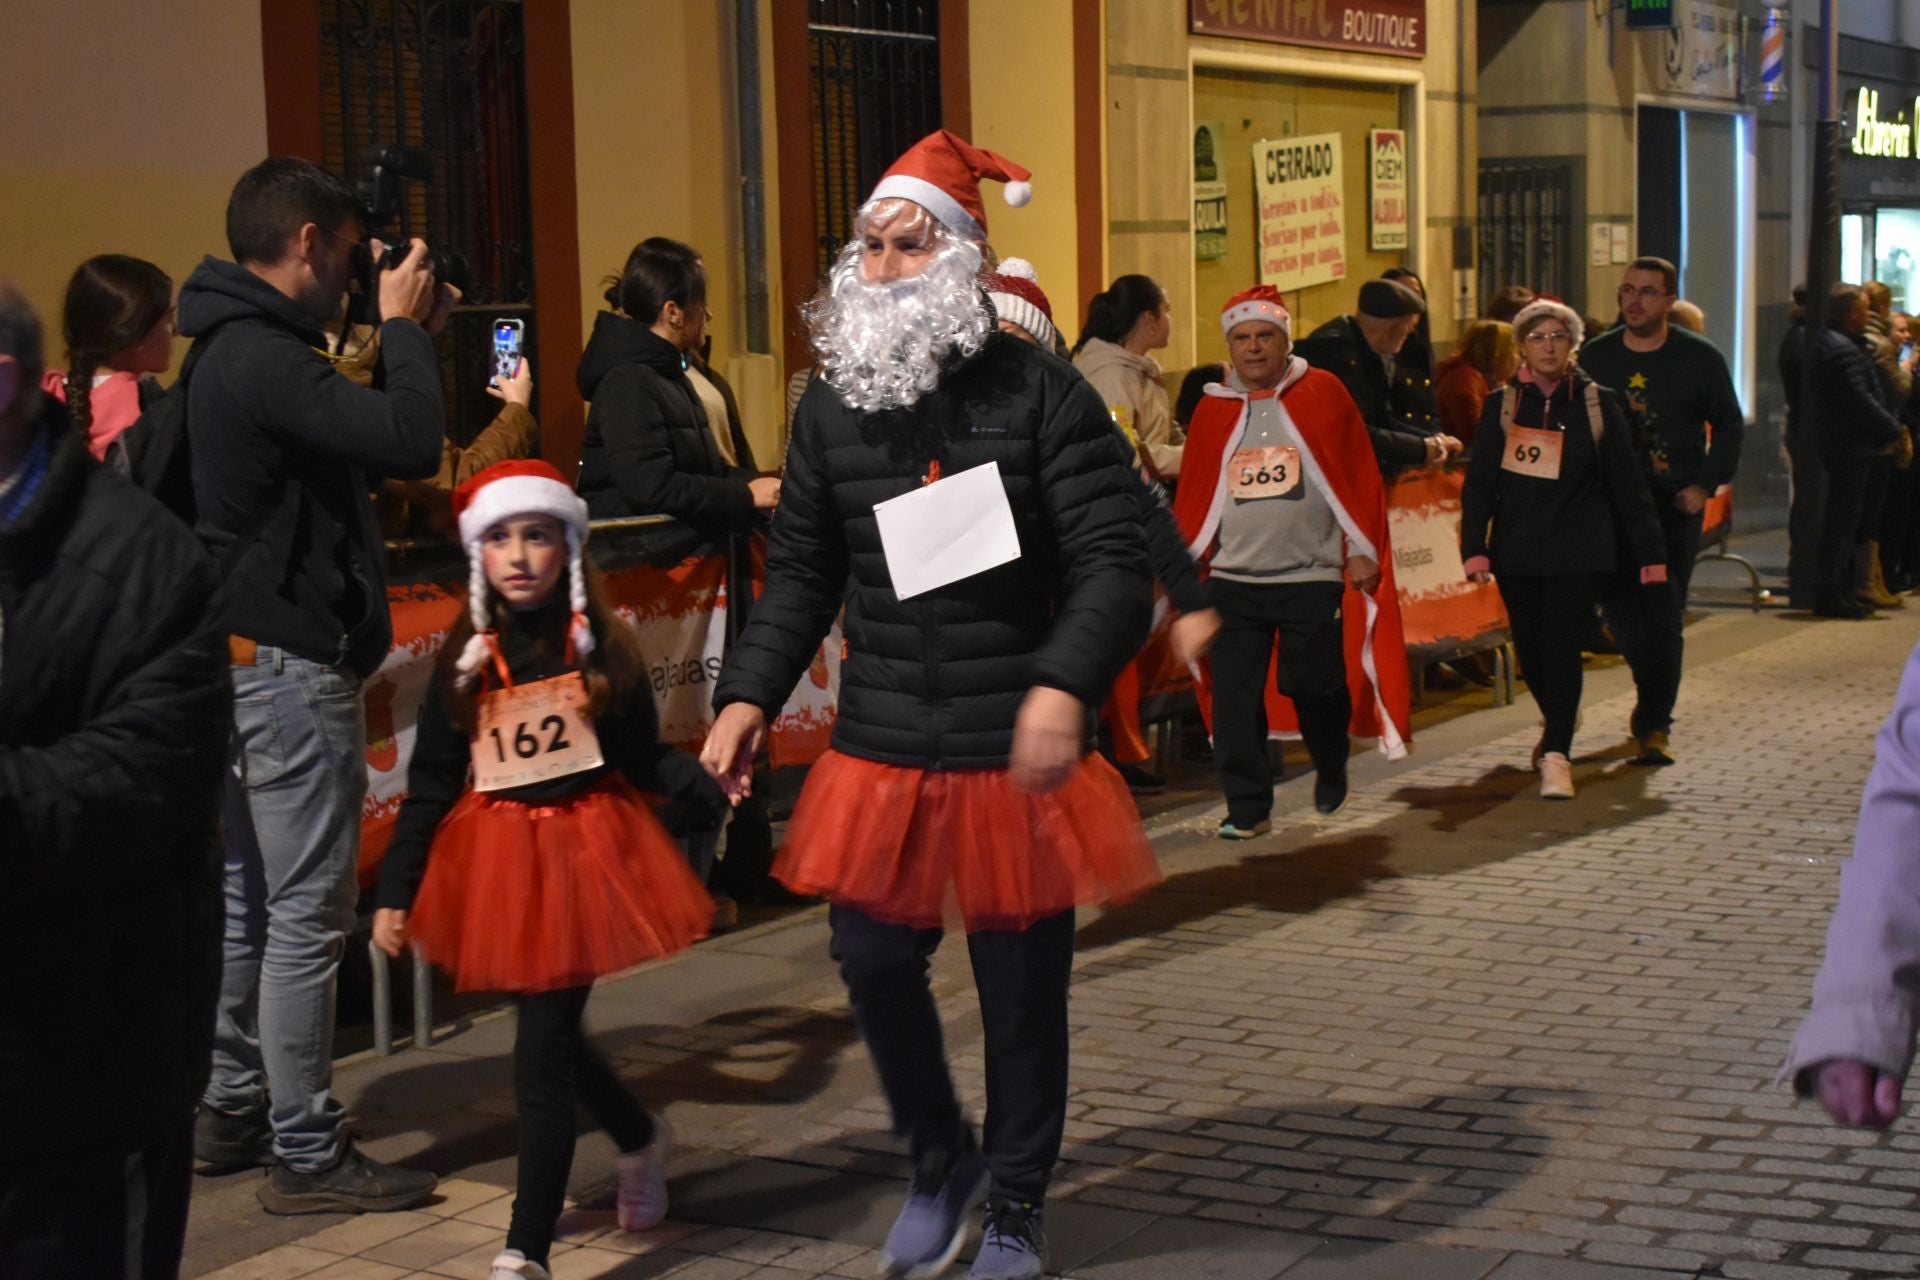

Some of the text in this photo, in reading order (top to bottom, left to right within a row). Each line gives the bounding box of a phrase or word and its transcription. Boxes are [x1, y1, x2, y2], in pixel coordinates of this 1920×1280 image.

[1342, 9, 1418, 48] BOUTIQUE
[1266, 142, 1333, 185] CERRADO
[1514, 443, 1542, 464] 69
[1240, 463, 1288, 487] 563
[490, 713, 572, 763] 162
